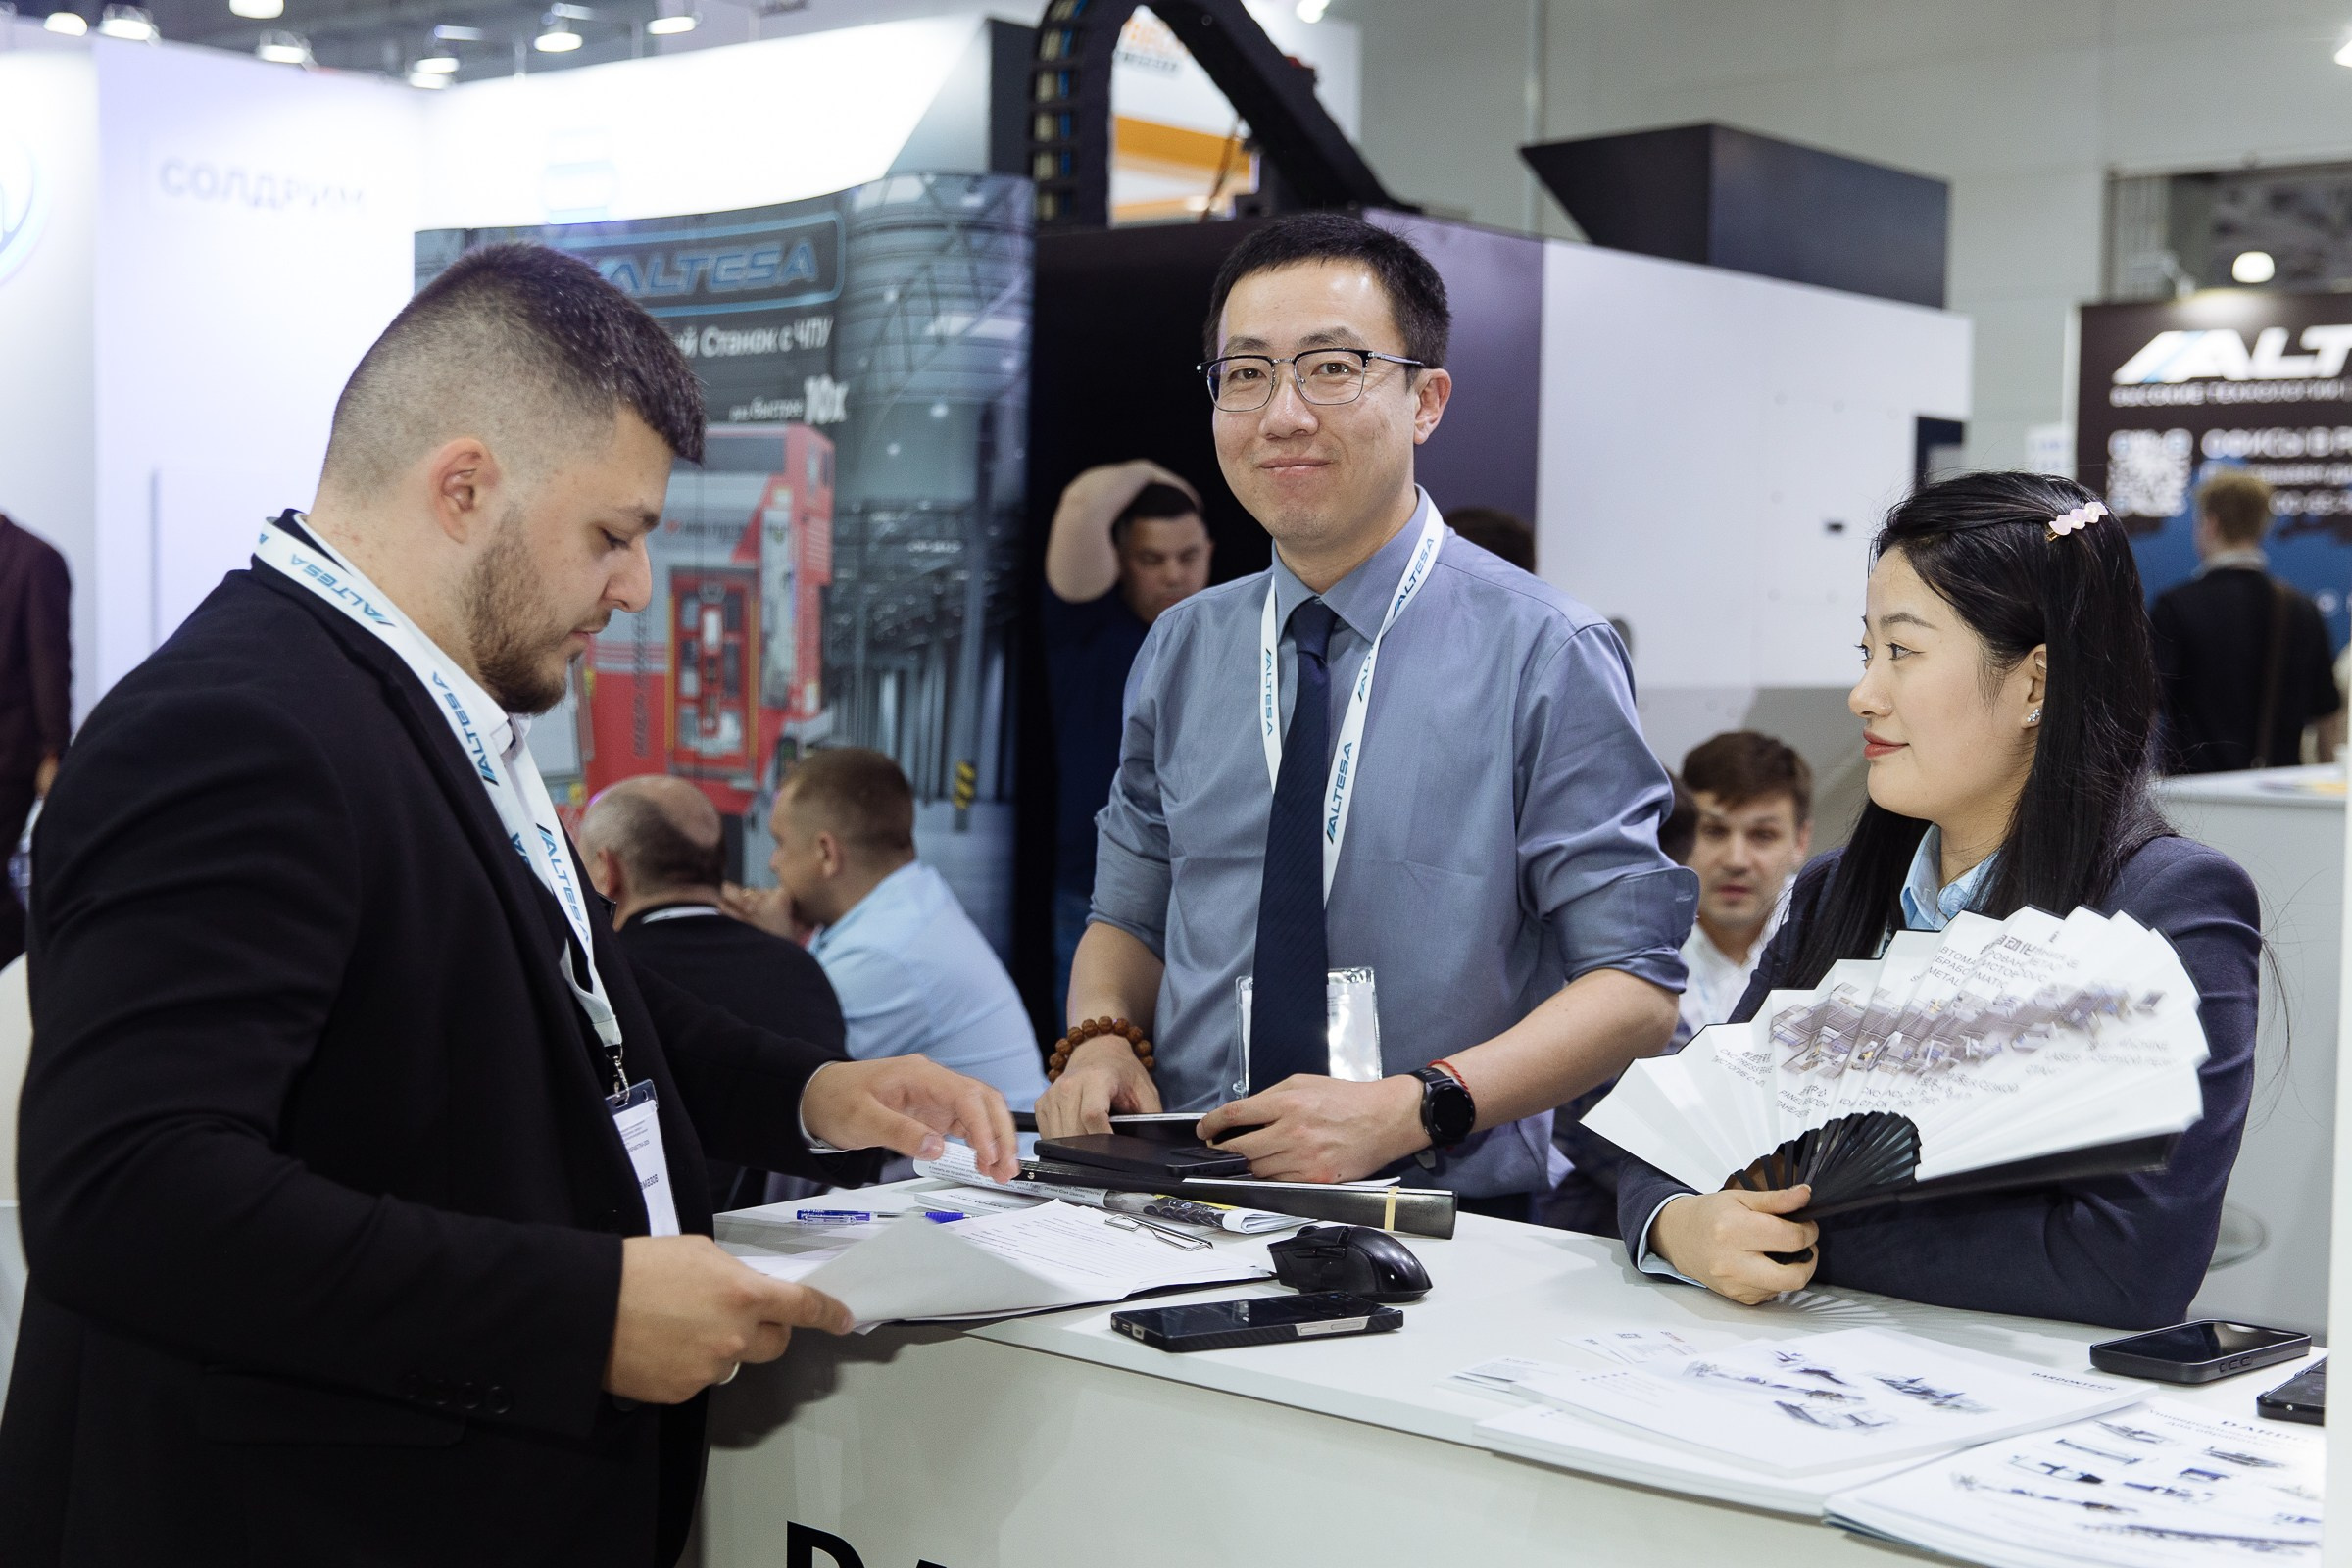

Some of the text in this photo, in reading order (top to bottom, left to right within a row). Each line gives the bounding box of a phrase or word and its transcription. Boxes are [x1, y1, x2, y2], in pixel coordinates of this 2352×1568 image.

[291, 554, 394, 626] ALTESA
[1393, 537, 1435, 618] ALTESA
[432, 671, 499, 786] ALTESA
[1264, 648, 1273, 736] ALTESA
[1327, 741, 1352, 845] ALTESA
